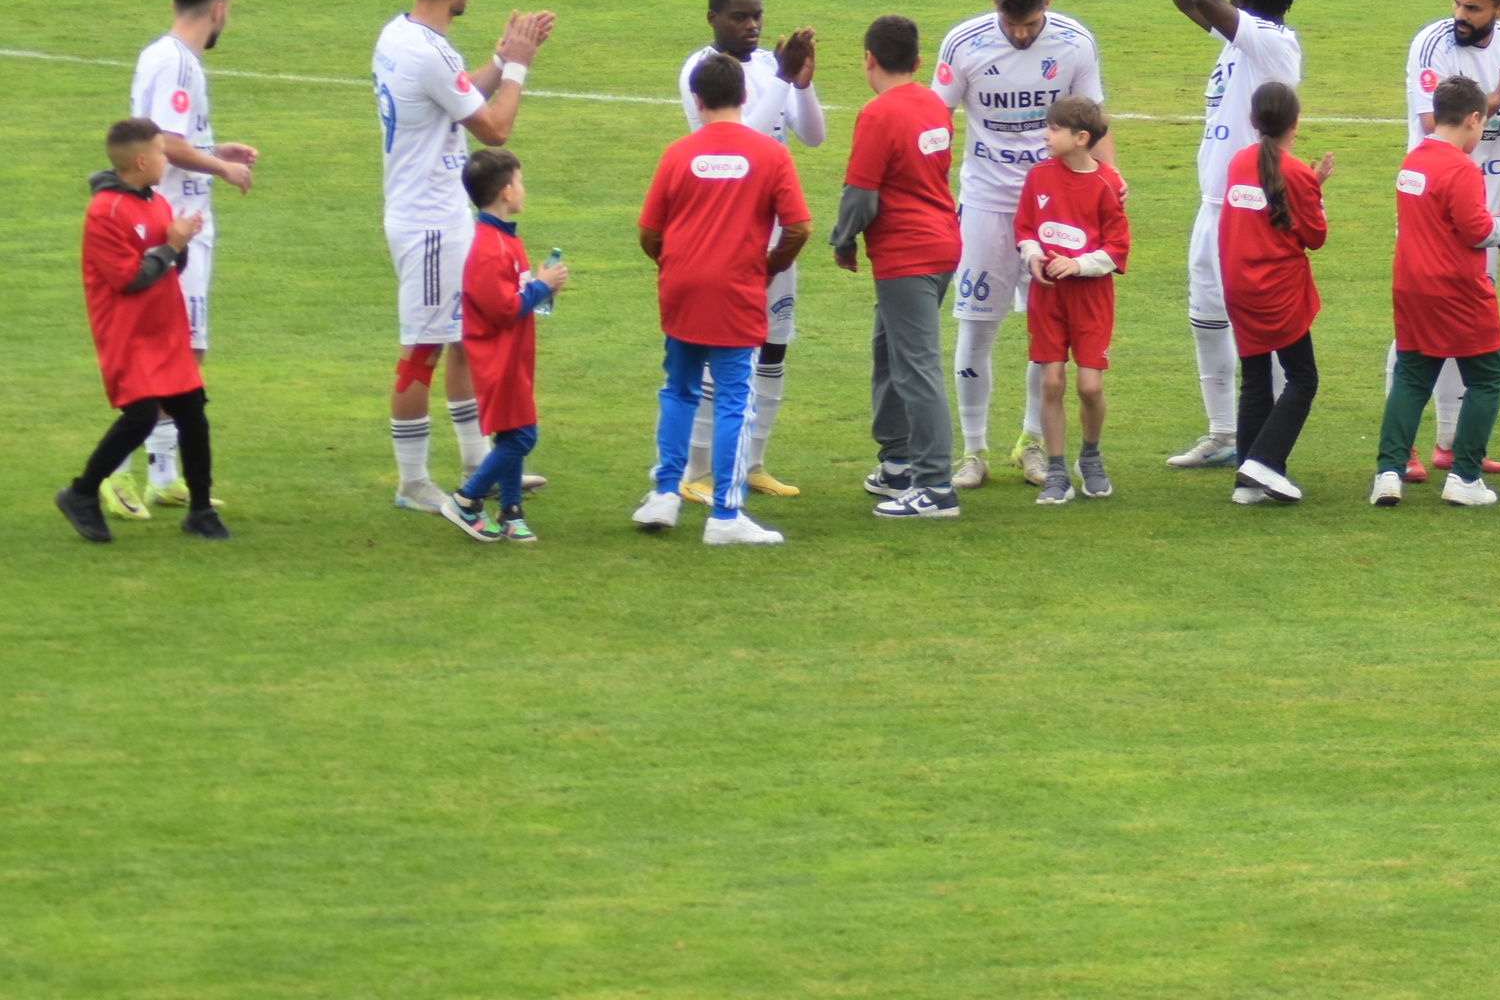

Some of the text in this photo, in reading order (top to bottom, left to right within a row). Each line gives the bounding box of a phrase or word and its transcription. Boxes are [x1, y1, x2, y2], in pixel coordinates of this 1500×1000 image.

[979, 89, 1061, 109] UNIBET
[711, 163, 743, 171] VEOLIA
[959, 268, 990, 301] 66
